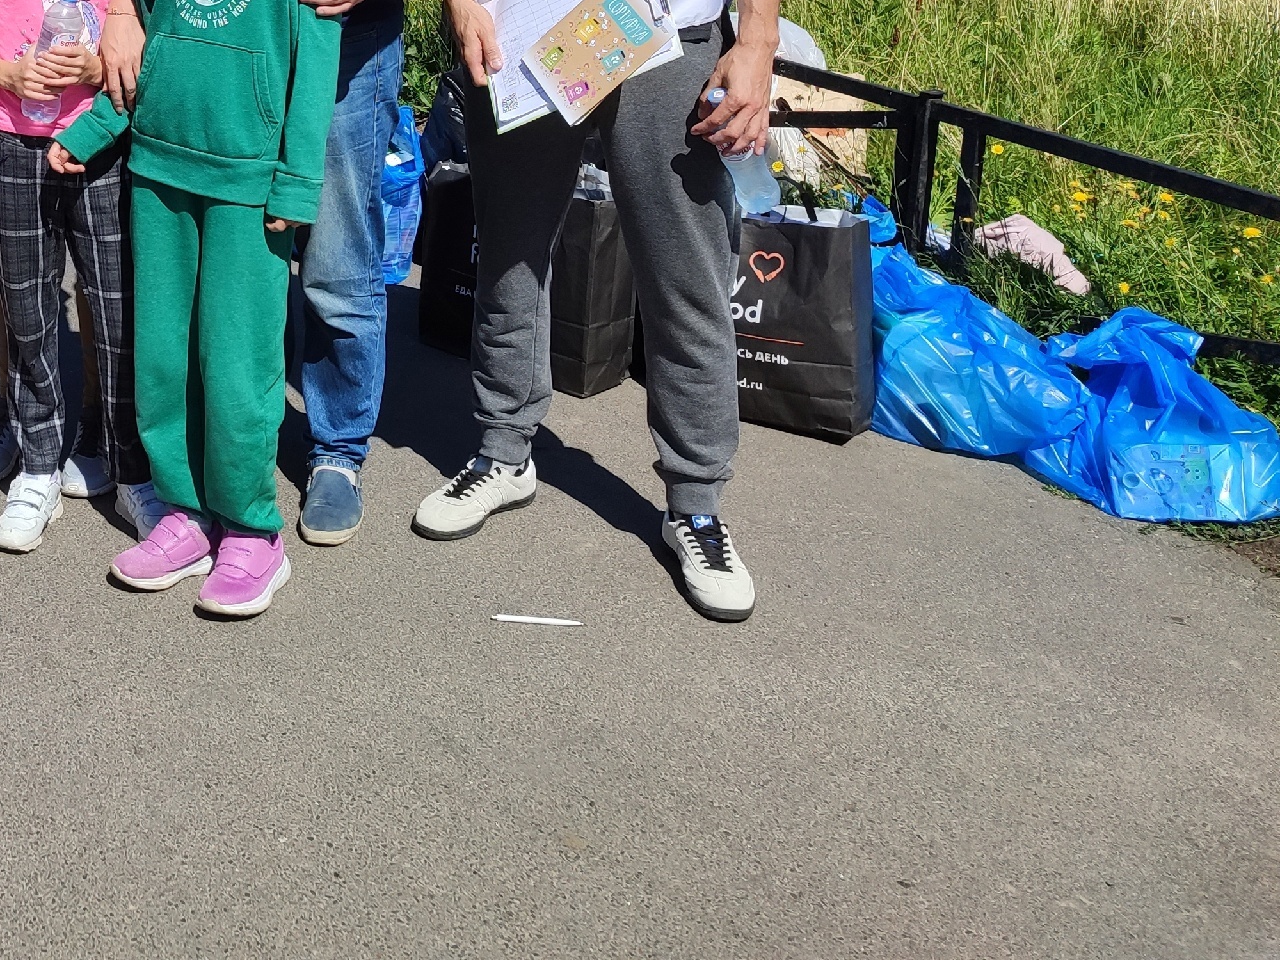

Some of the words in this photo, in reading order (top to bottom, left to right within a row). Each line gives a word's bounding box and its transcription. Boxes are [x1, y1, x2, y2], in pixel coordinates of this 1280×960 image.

[179, 9, 208, 29] AROUND
[212, 15, 229, 29] THE
[754, 351, 789, 366] ДЕНЬ
